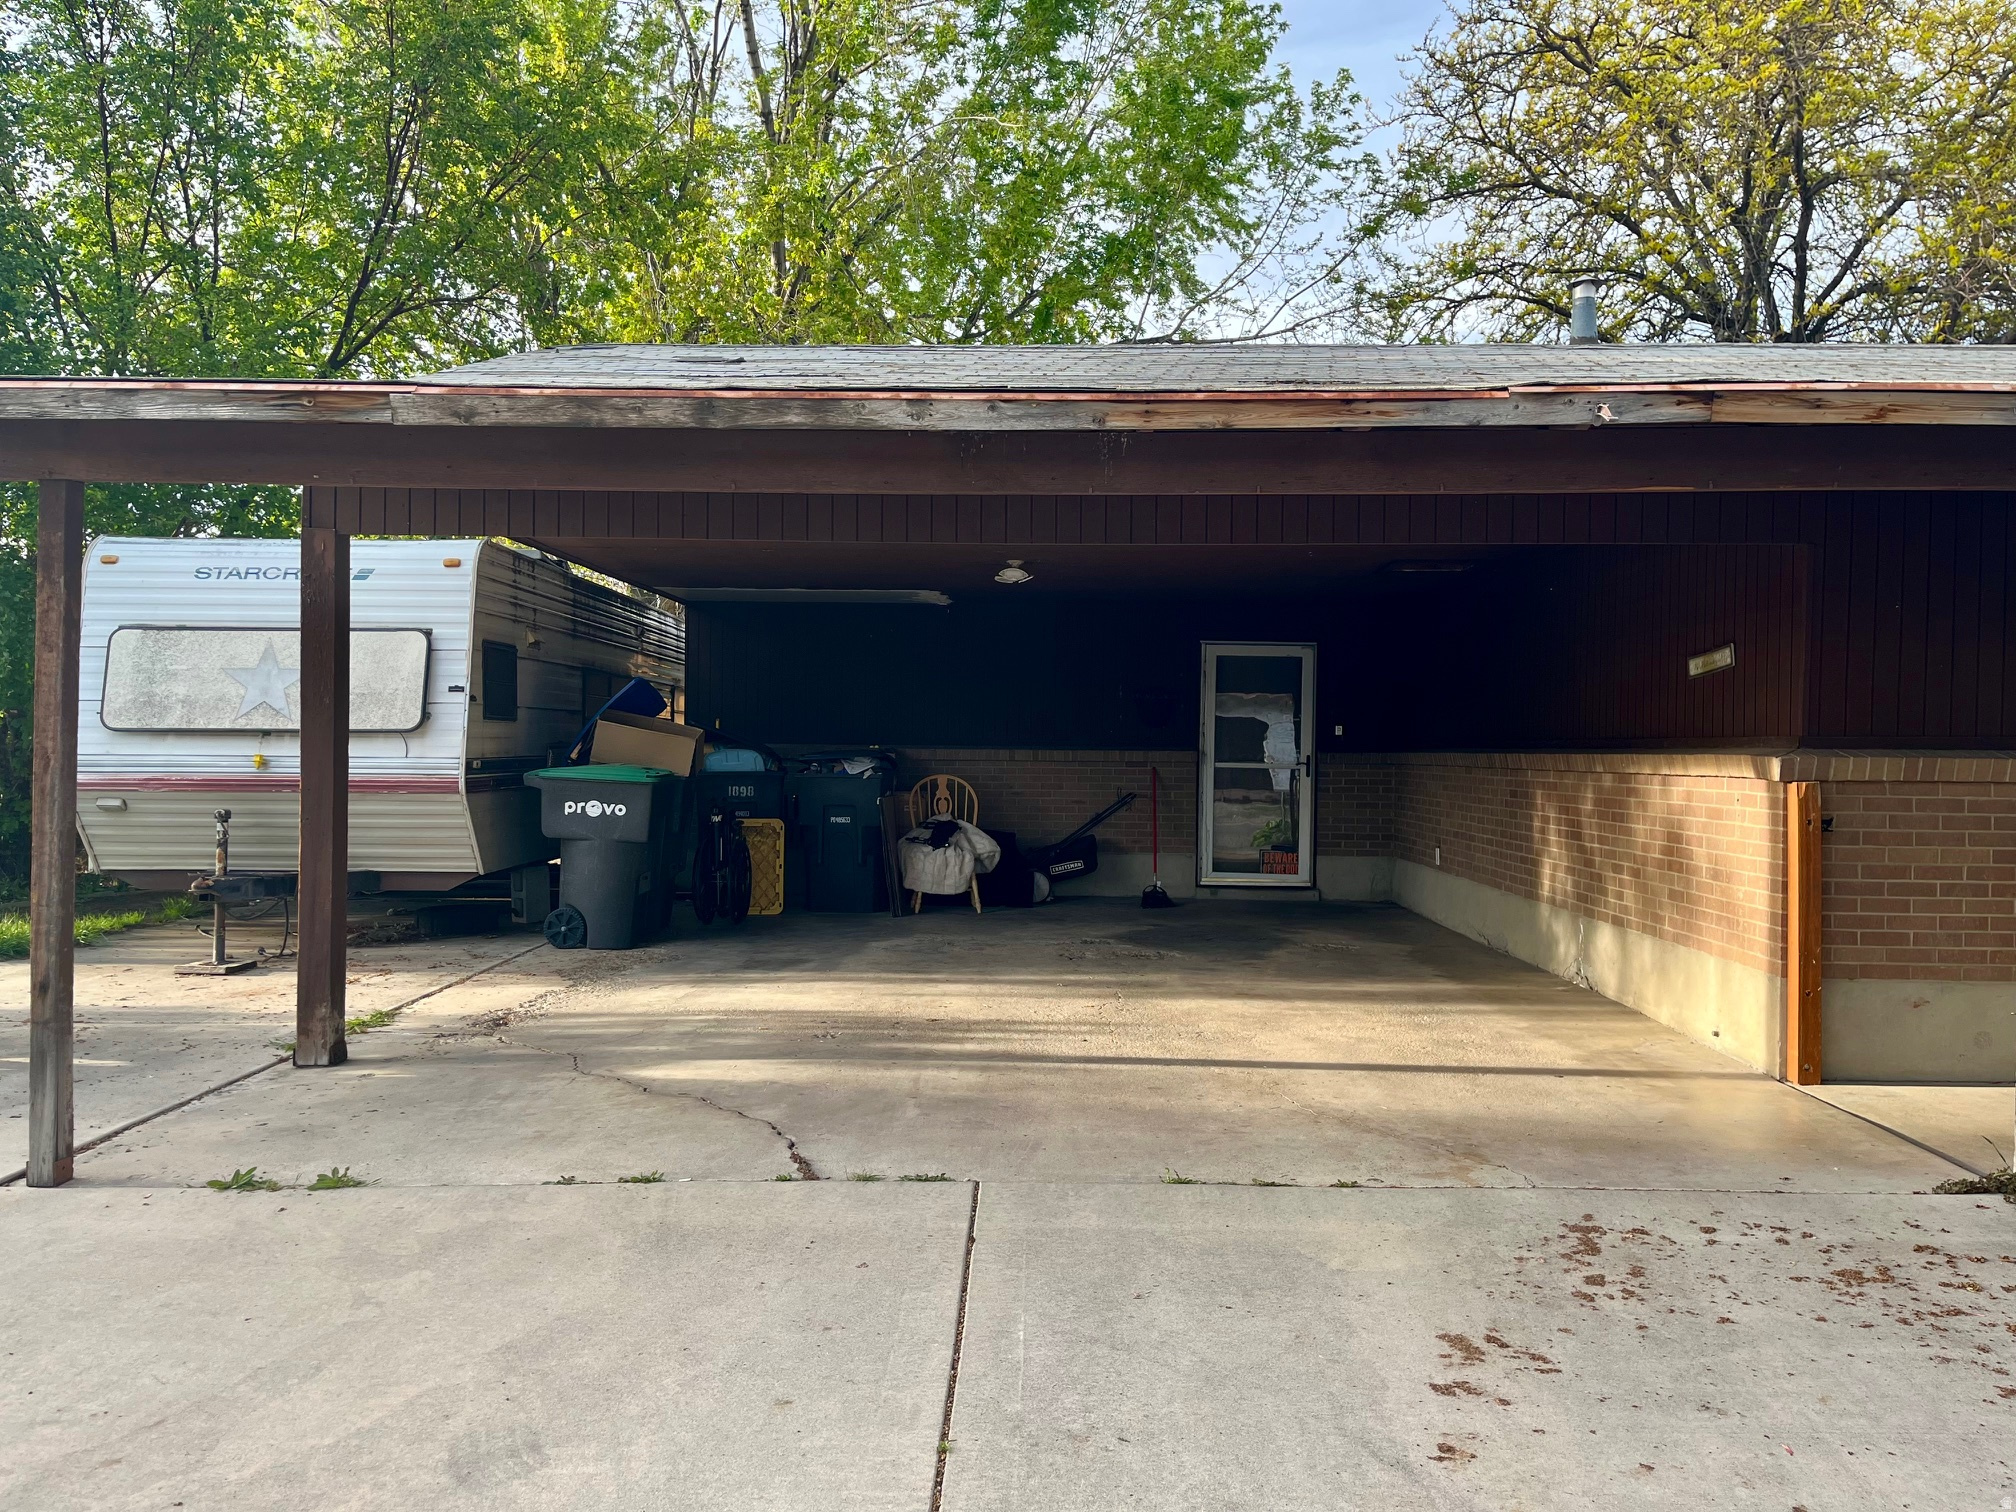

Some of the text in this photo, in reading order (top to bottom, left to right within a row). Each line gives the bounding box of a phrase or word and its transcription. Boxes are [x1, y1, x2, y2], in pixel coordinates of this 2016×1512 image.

[193, 566, 352, 580] STARCR
[728, 786, 755, 797] 1898
[564, 800, 627, 817] provo
[1263, 852, 1298, 864] BEWARE
[1052, 862, 1082, 873] CRAFTSMAN
[1263, 863, 1270, 874] OF
[1273, 863, 1285, 874] THE
